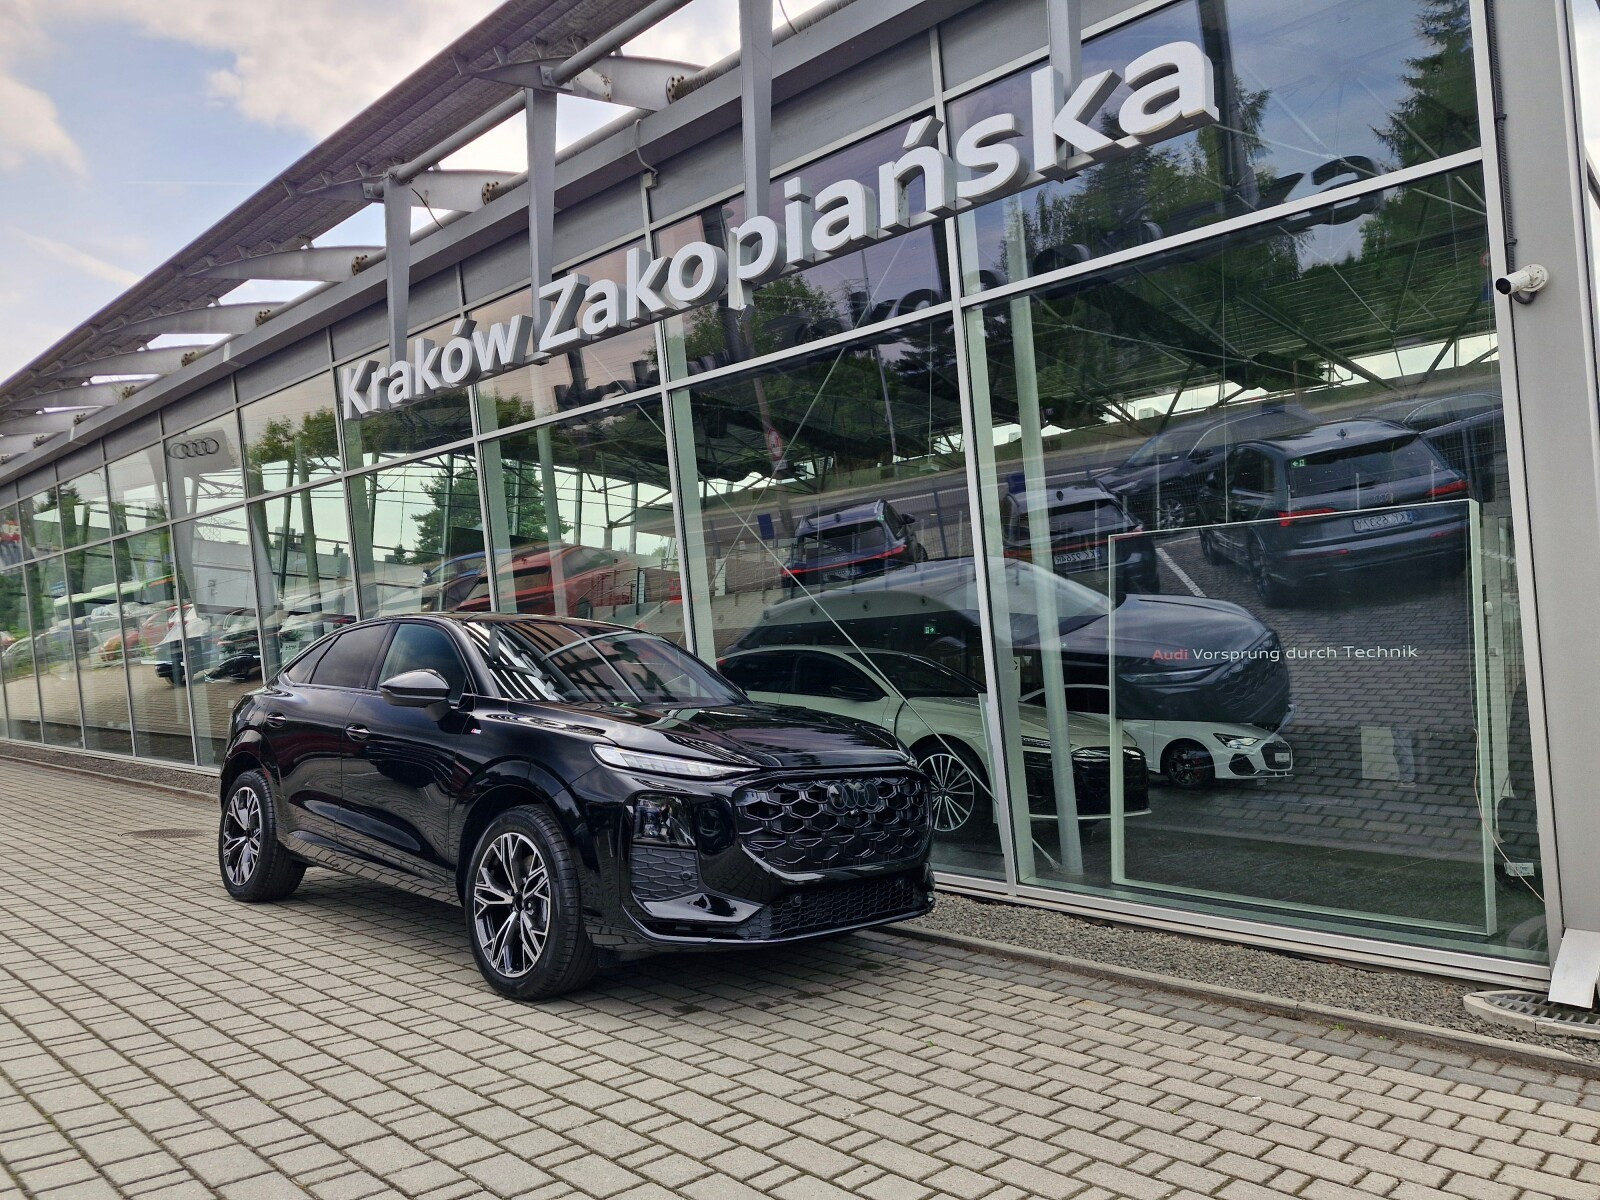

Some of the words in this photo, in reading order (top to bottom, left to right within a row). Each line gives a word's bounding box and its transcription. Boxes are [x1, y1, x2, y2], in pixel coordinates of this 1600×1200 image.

[342, 314, 531, 420] Kraków
[538, 40, 1217, 352] Zakopiańska
[1152, 648, 1189, 661] Audi
[1192, 648, 1281, 662] Vorsprung
[1285, 646, 1338, 660] durch
[1342, 645, 1419, 660] Technik
